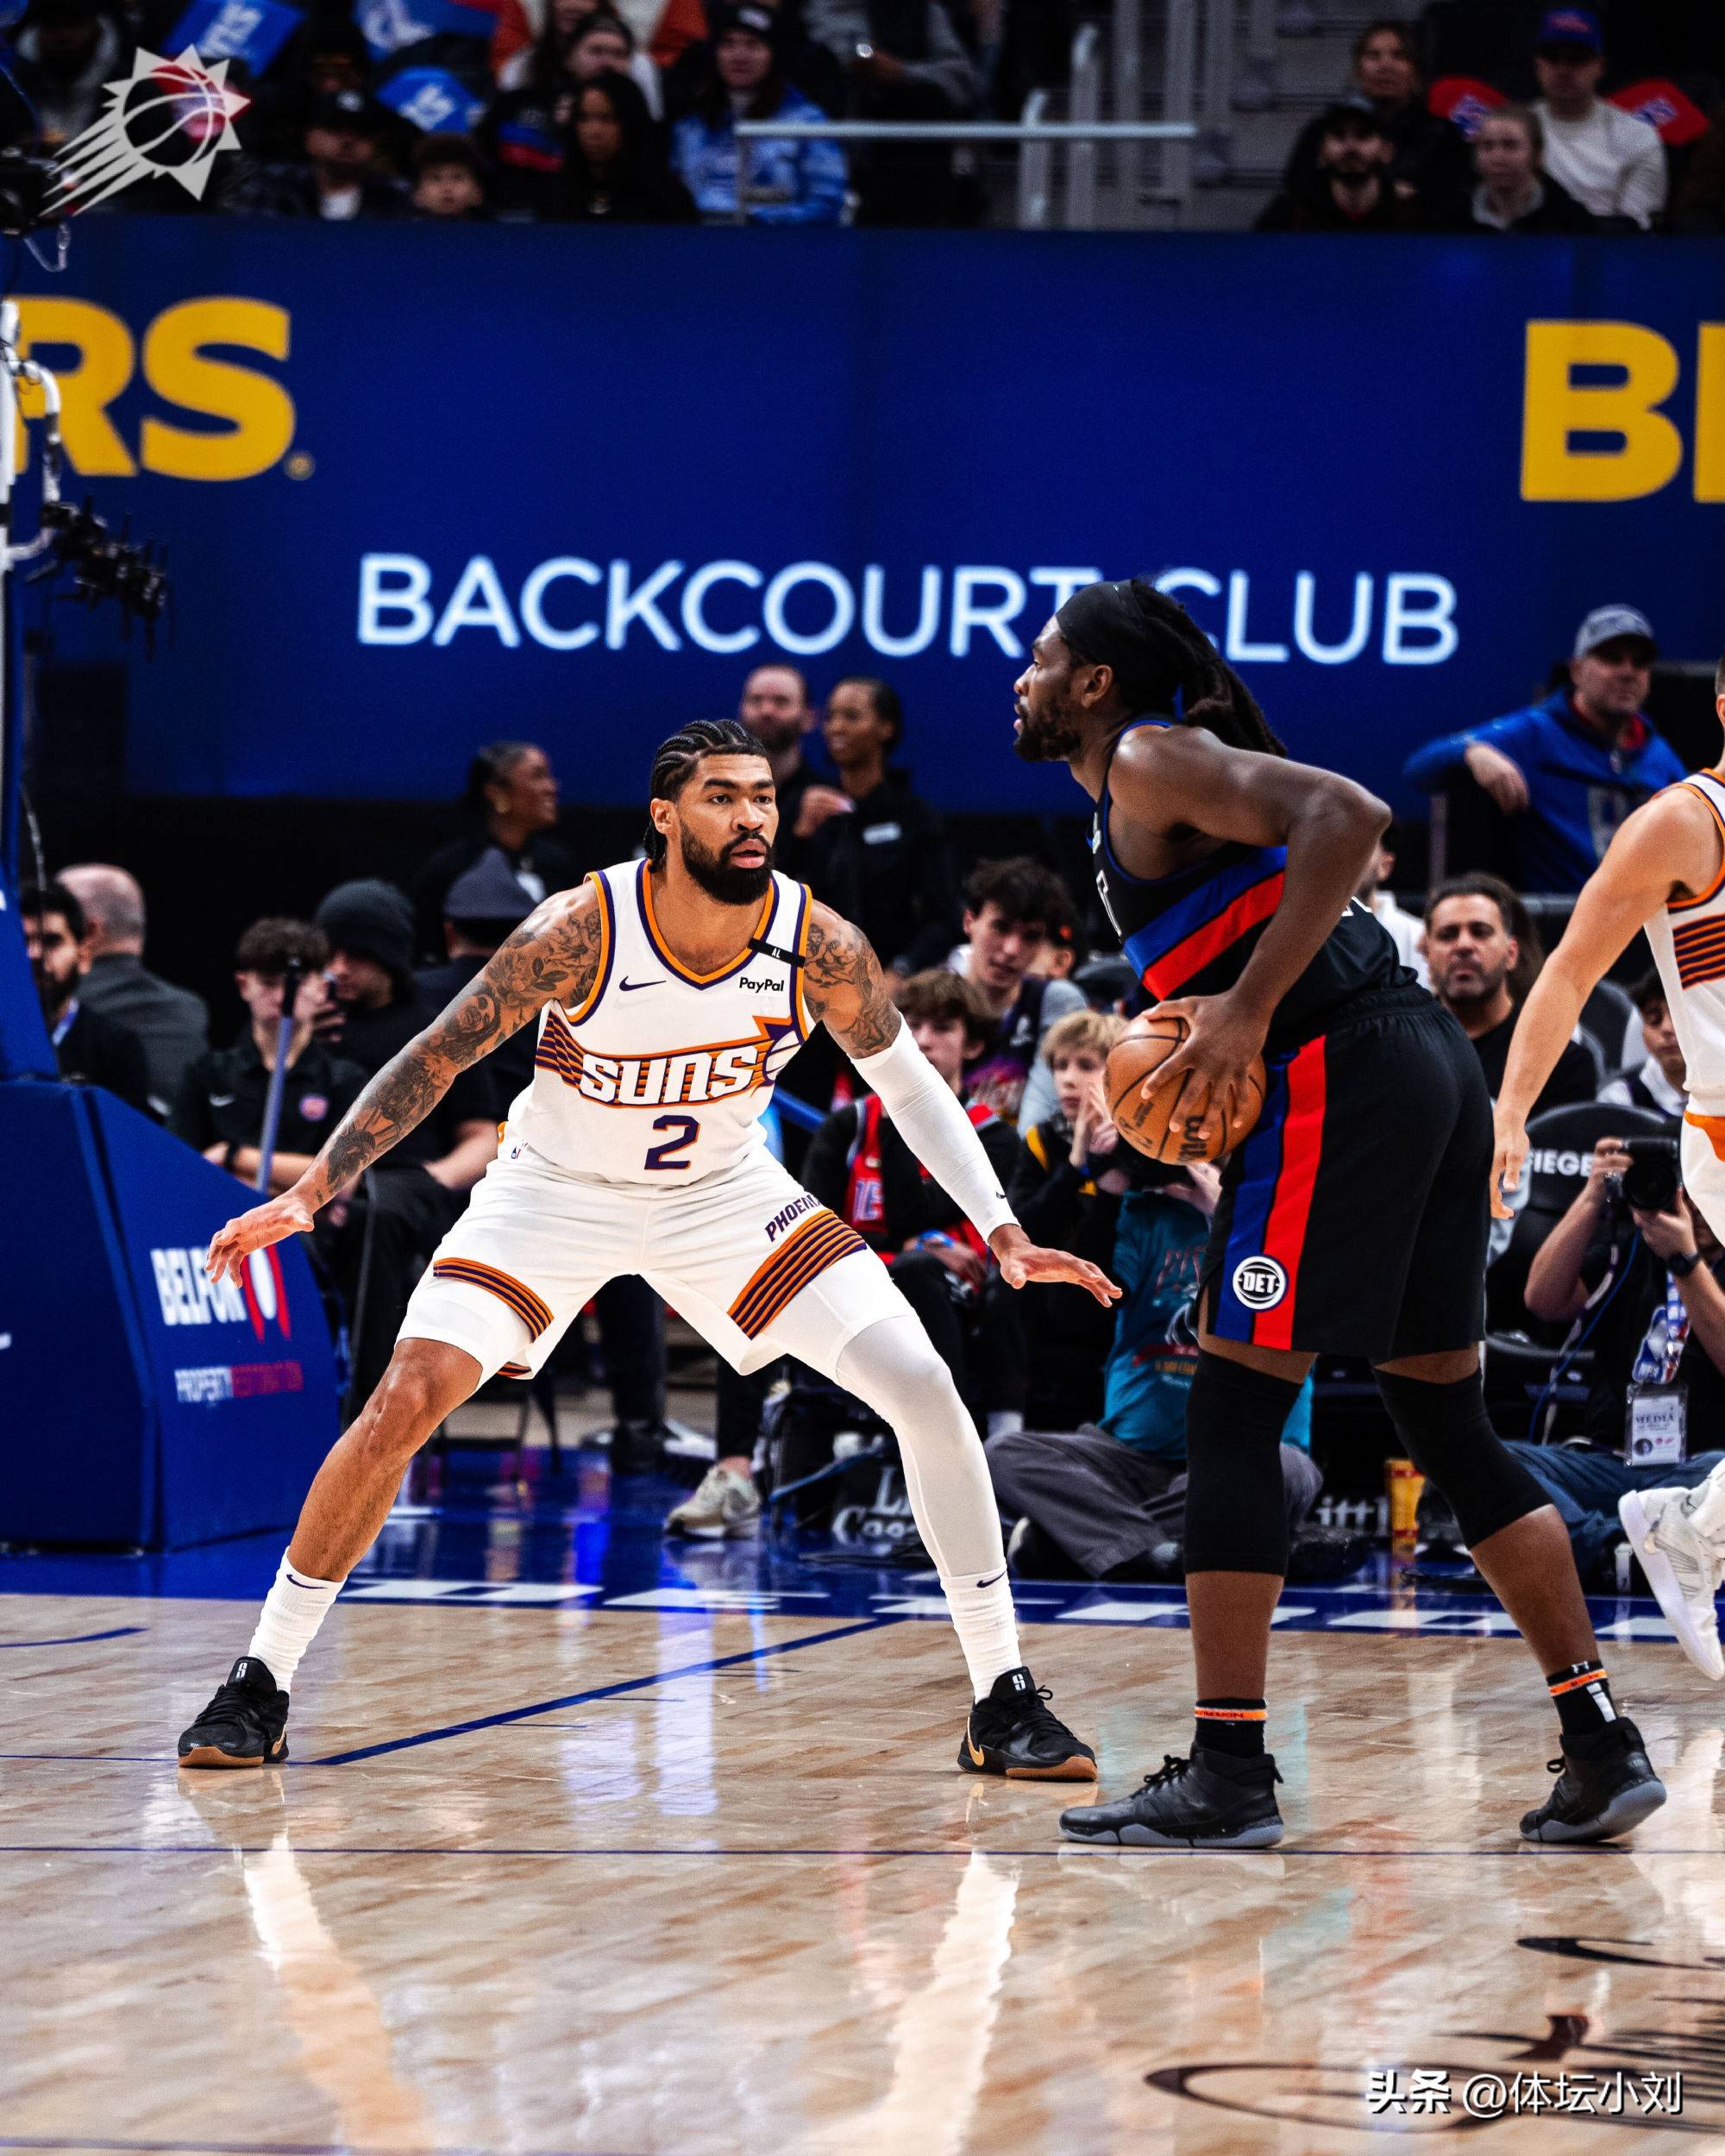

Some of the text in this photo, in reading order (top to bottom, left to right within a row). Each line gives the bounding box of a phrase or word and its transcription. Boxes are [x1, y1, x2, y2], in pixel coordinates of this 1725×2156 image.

[357, 553, 1103, 658] BACKCOURT
[739, 976, 784, 993] PayPal
[643, 1113, 700, 1171] 2
[764, 1194, 820, 1243] PHOENI
[1243, 1271, 1276, 1294] DET
